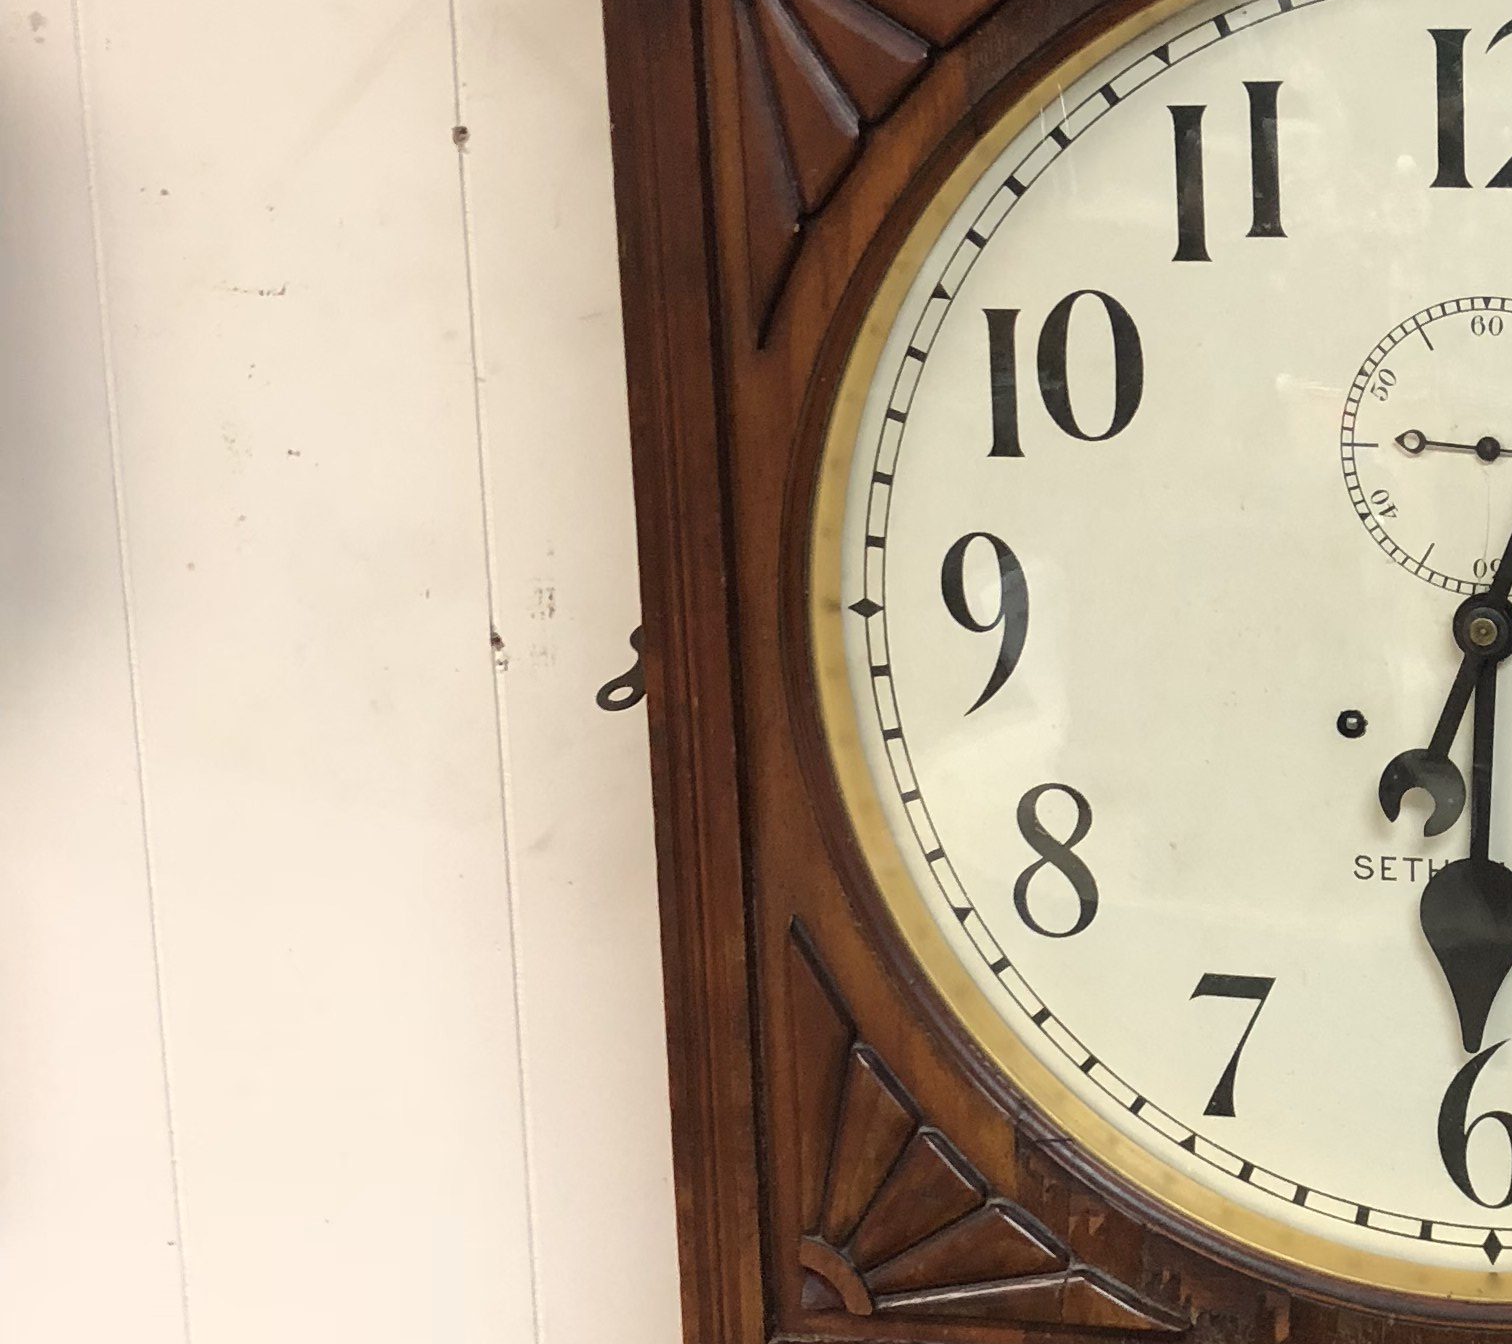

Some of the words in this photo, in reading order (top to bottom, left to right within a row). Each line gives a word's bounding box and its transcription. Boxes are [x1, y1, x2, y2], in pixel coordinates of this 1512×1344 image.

[1166, 80, 1288, 262] 11
[982, 288, 1145, 458] 10
[1369, 367, 1398, 402] 50
[1470, 314, 1504, 336] 60
[1369, 488, 1400, 521] 40
[940, 531, 1029, 716] 9
[1011, 782, 1100, 939] 8
[1189, 972, 1277, 1119] 7
